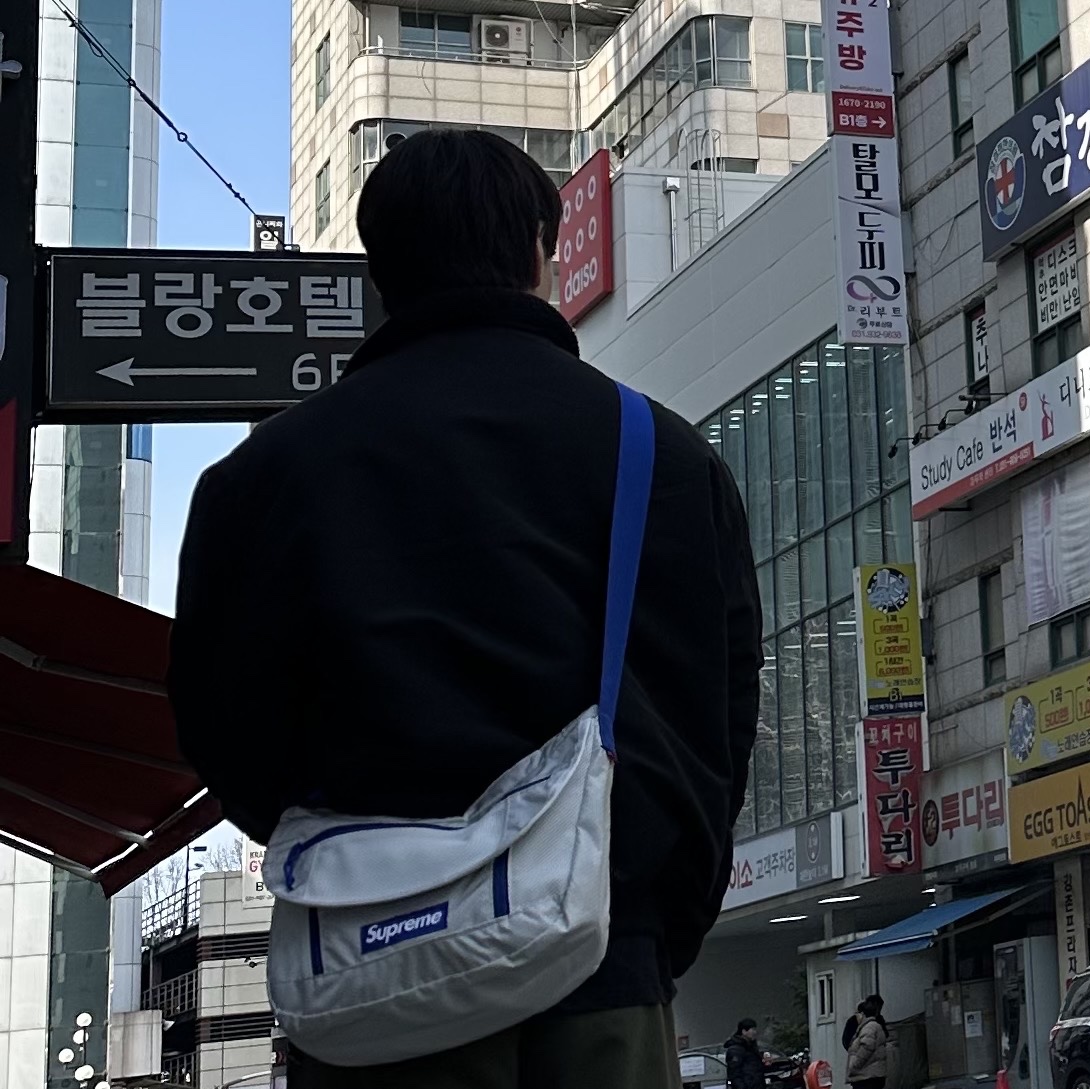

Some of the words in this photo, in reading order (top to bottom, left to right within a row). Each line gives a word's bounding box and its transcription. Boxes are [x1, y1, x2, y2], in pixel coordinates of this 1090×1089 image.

[836, 0, 867, 71] 주방
[1048, 238, 1077, 269] 디스크
[75, 272, 366, 338] 블랑호텔
[564, 256, 598, 304] daiso
[976, 317, 989, 373] 추나
[291, 352, 354, 391] 6F
[921, 454, 953, 491] Study
[956, 437, 984, 471] Cafe
[989, 408, 1017, 453] 반석
[872, 748, 916, 864] 투다리
[941, 779, 1003, 840] 투다리
[1024, 808, 1054, 840] EGG
[729, 858, 753, 889] 이소
[365, 909, 443, 947] Supreme
